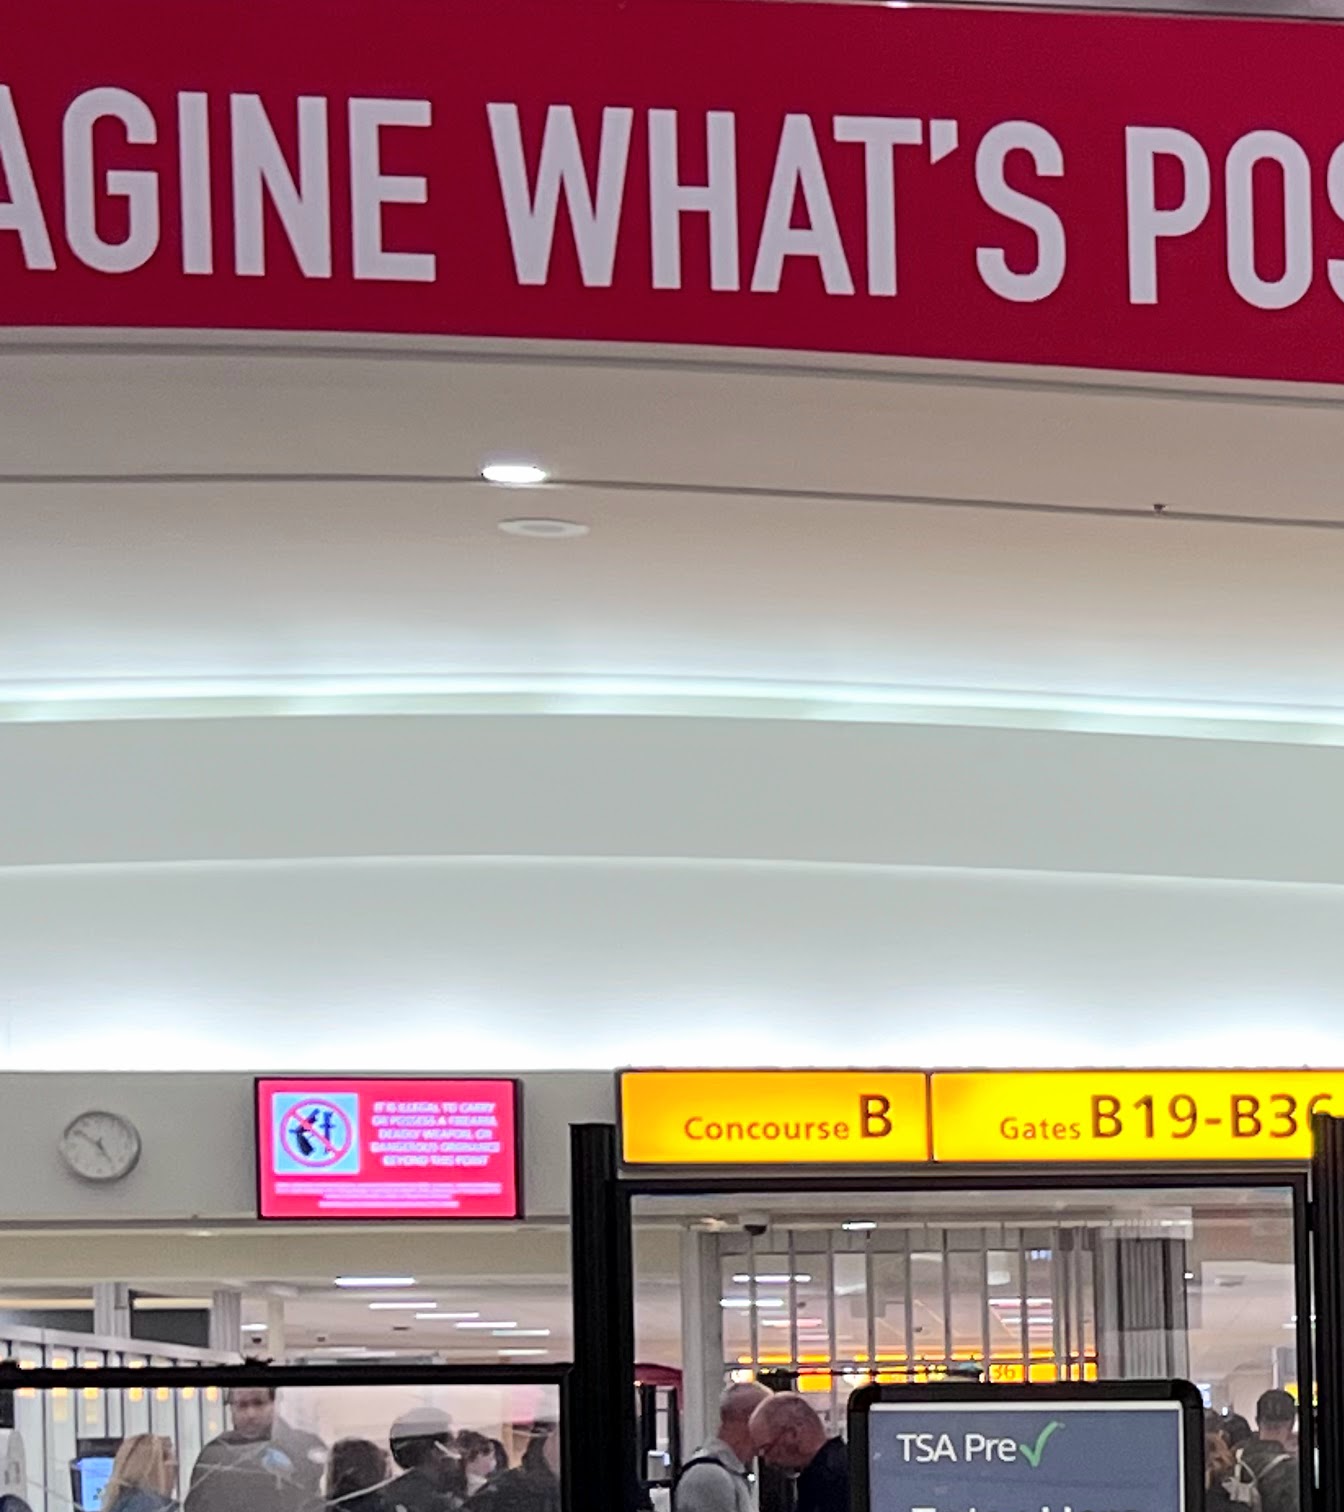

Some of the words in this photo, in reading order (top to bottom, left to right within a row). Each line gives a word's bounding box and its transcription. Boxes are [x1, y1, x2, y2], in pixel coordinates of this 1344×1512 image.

[0, 84, 437, 282] AGINE
[486, 101, 1067, 303] WHAT'S
[684, 1115, 850, 1141] Concourse
[859, 1093, 893, 1139] B
[999, 1115, 1082, 1142] Gates
[896, 1433, 958, 1463] TSA
[965, 1433, 1018, 1462] Pre
